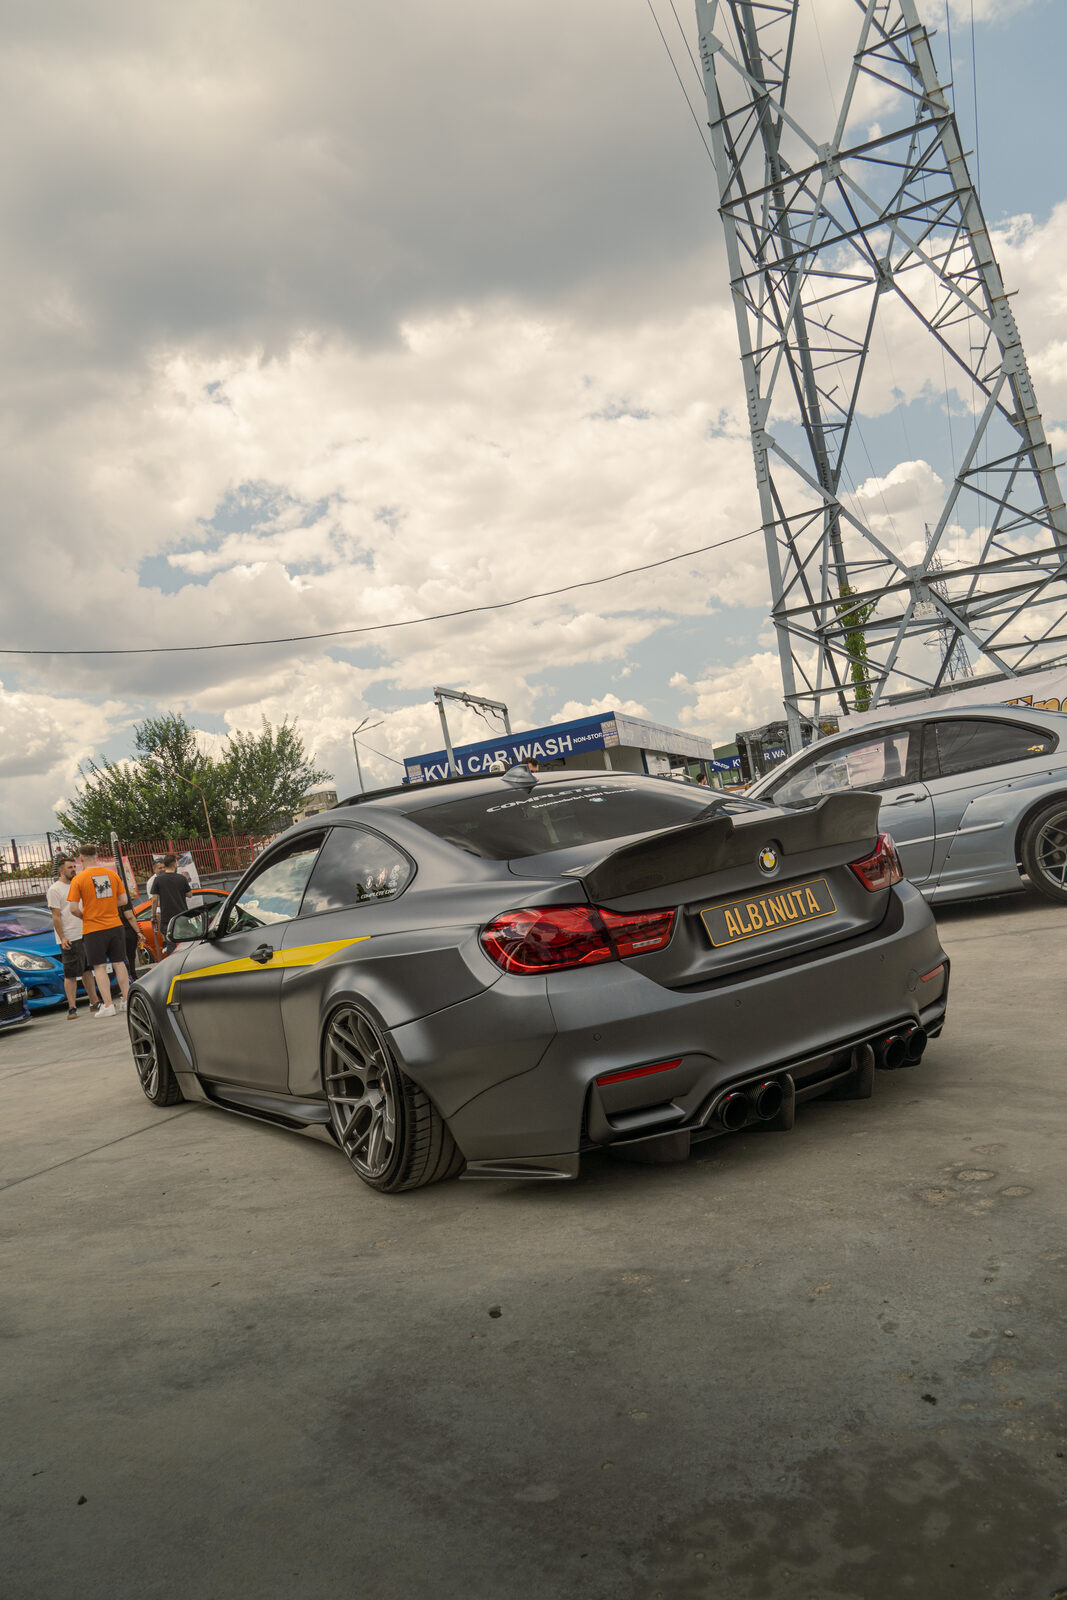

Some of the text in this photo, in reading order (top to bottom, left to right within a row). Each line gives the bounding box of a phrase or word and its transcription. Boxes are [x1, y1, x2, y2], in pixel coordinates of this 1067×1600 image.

[424, 760, 463, 781] KVN
[467, 750, 512, 773] CAR
[512, 735, 573, 762] WASH
[732, 759, 741, 768] K
[771, 749, 786, 759] WA
[723, 887, 821, 938] ALBINUTA
